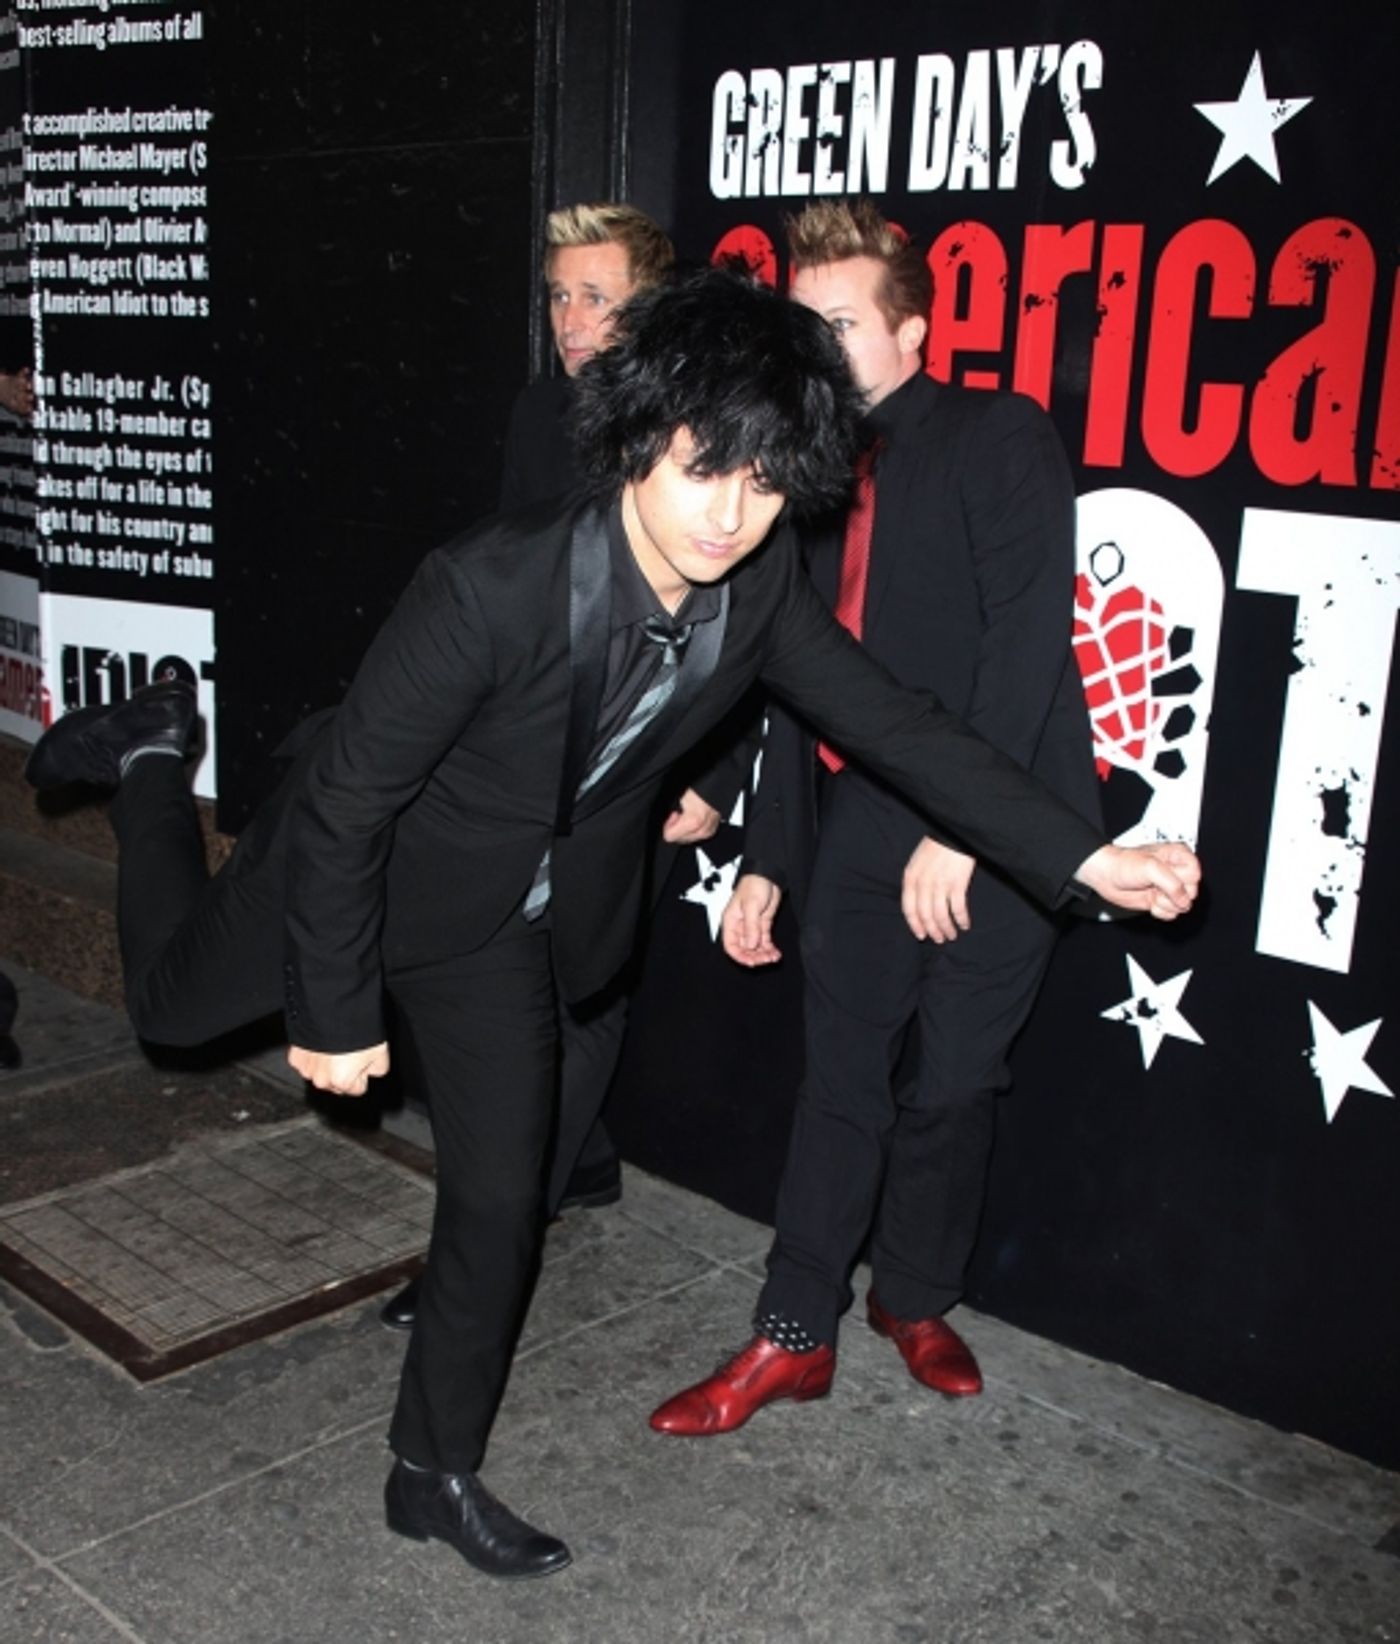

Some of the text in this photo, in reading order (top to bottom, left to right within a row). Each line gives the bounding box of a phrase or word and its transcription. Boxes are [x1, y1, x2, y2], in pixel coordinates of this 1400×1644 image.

[107, 16, 162, 43] albums
[164, 13, 181, 40] of
[182, 11, 203, 40] all
[33, 107, 131, 140] accomplished
[131, 104, 193, 132] creative
[708, 40, 1103, 199] GREEN DAY'S
[79, 144, 138, 169] Michael
[139, 142, 187, 175] Mayer
[52, 216, 112, 250] Normal)
[113, 217, 142, 243] and
[142, 216, 193, 243] Olivier
[68, 254, 133, 285] Hoggett
[134, 252, 188, 286] (Black
[43, 289, 111, 315] American
[112, 290, 149, 317] Idiot
[150, 294, 169, 317] to
[169, 290, 198, 317] the
[711, 219, 1400, 490] erica
[61, 371, 144, 404] Gallagher
[151, 375, 175, 401] Jr.
[96, 408, 187, 437] 19-member
[52, 440, 114, 473] through
[115, 443, 143, 470] the
[145, 449, 183, 477] eyes
[184, 447, 205, 473] of
[76, 476, 99, 501] off
[101, 476, 124, 503] for
[126, 484, 137, 504] a
[138, 478, 167, 506] life
[167, 481, 185, 507] in
[71, 508, 96, 533] for
[96, 509, 122, 536] his
[123, 518, 187, 547] country
[67, 541, 95, 567] the
[97, 545, 151, 578] safety
[151, 550, 171, 574] of
